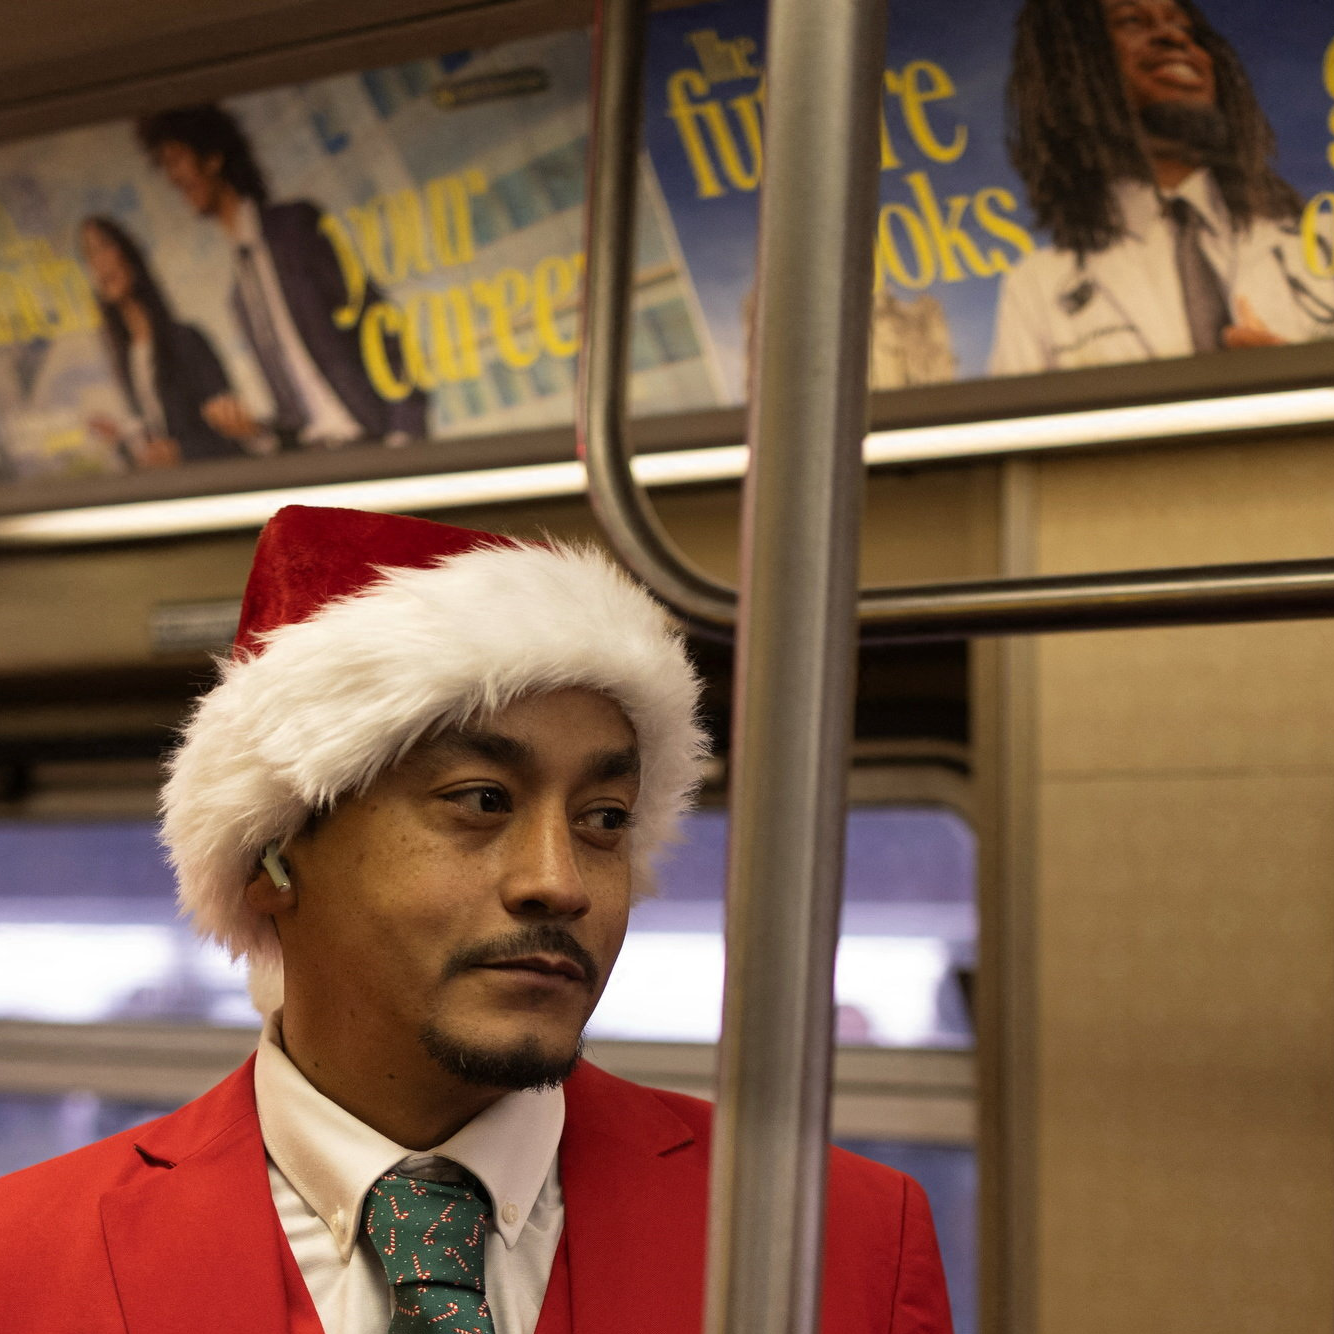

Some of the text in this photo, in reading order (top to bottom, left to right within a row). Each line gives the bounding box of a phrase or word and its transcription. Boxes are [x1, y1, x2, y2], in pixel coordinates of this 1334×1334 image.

[665, 59, 968, 198] fure
[319, 170, 488, 330] your
[871, 172, 1038, 299] oks
[360, 253, 586, 401] caree
